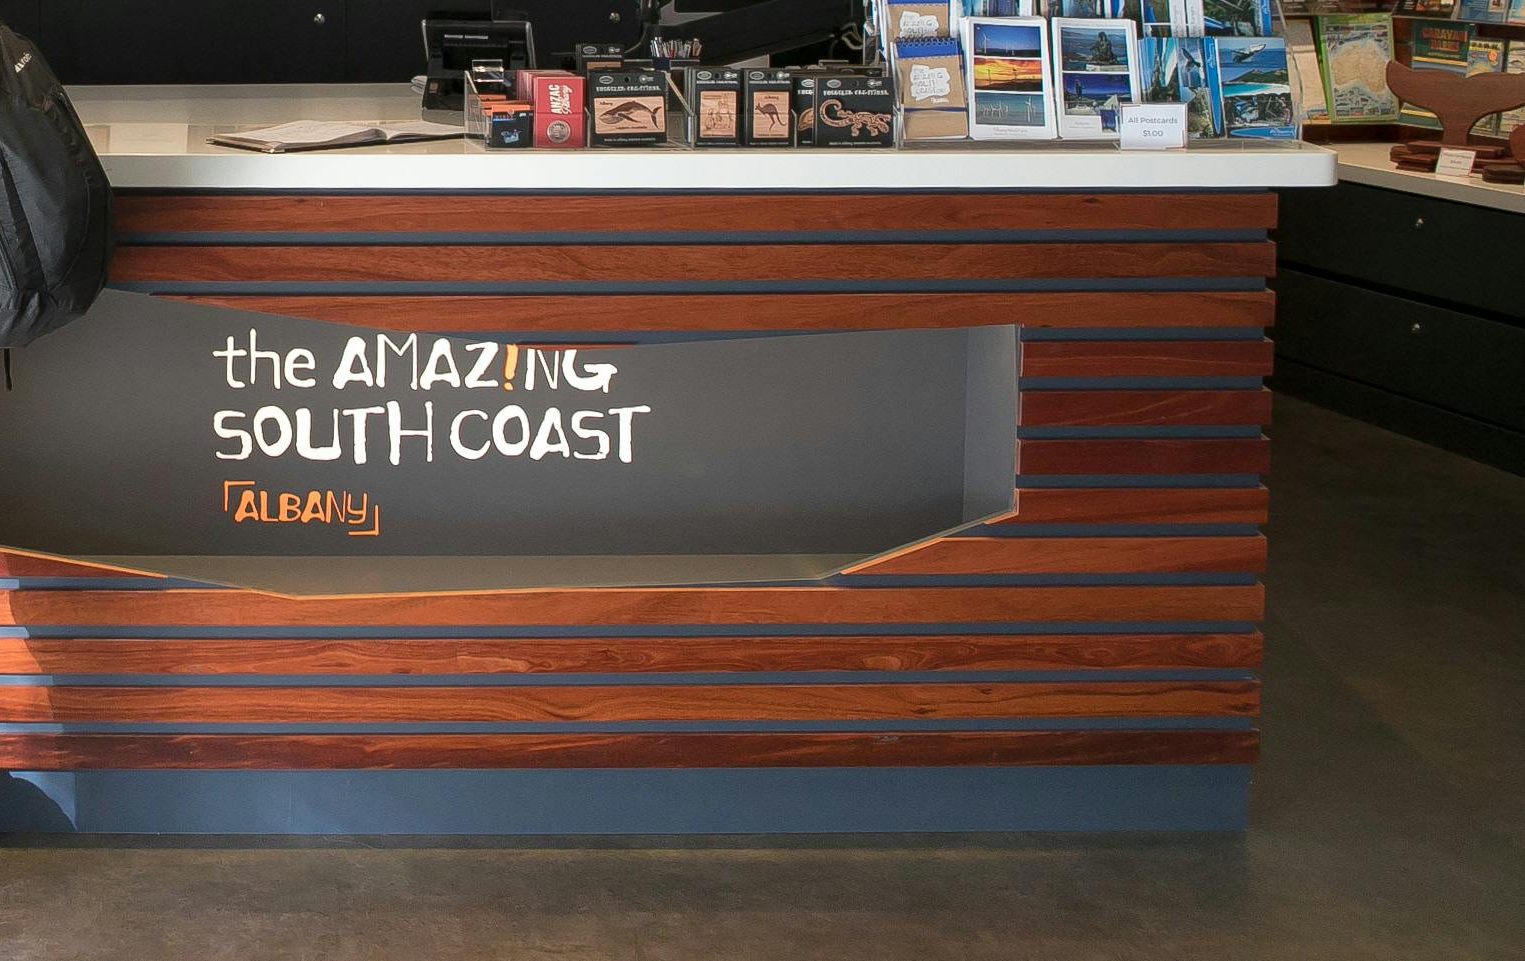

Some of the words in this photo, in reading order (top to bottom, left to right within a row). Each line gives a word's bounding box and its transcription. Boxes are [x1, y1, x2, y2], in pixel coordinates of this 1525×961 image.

[548, 84, 562, 114] ANZAC
[1128, 116, 1139, 124] All
[1140, 116, 1178, 124] Postcards
[212, 327, 317, 390] the
[332, 332, 618, 393] AMAZ!NG
[212, 400, 433, 466] SOUTH
[449, 404, 651, 464] COAST
[232, 488, 370, 526] ALBANY
